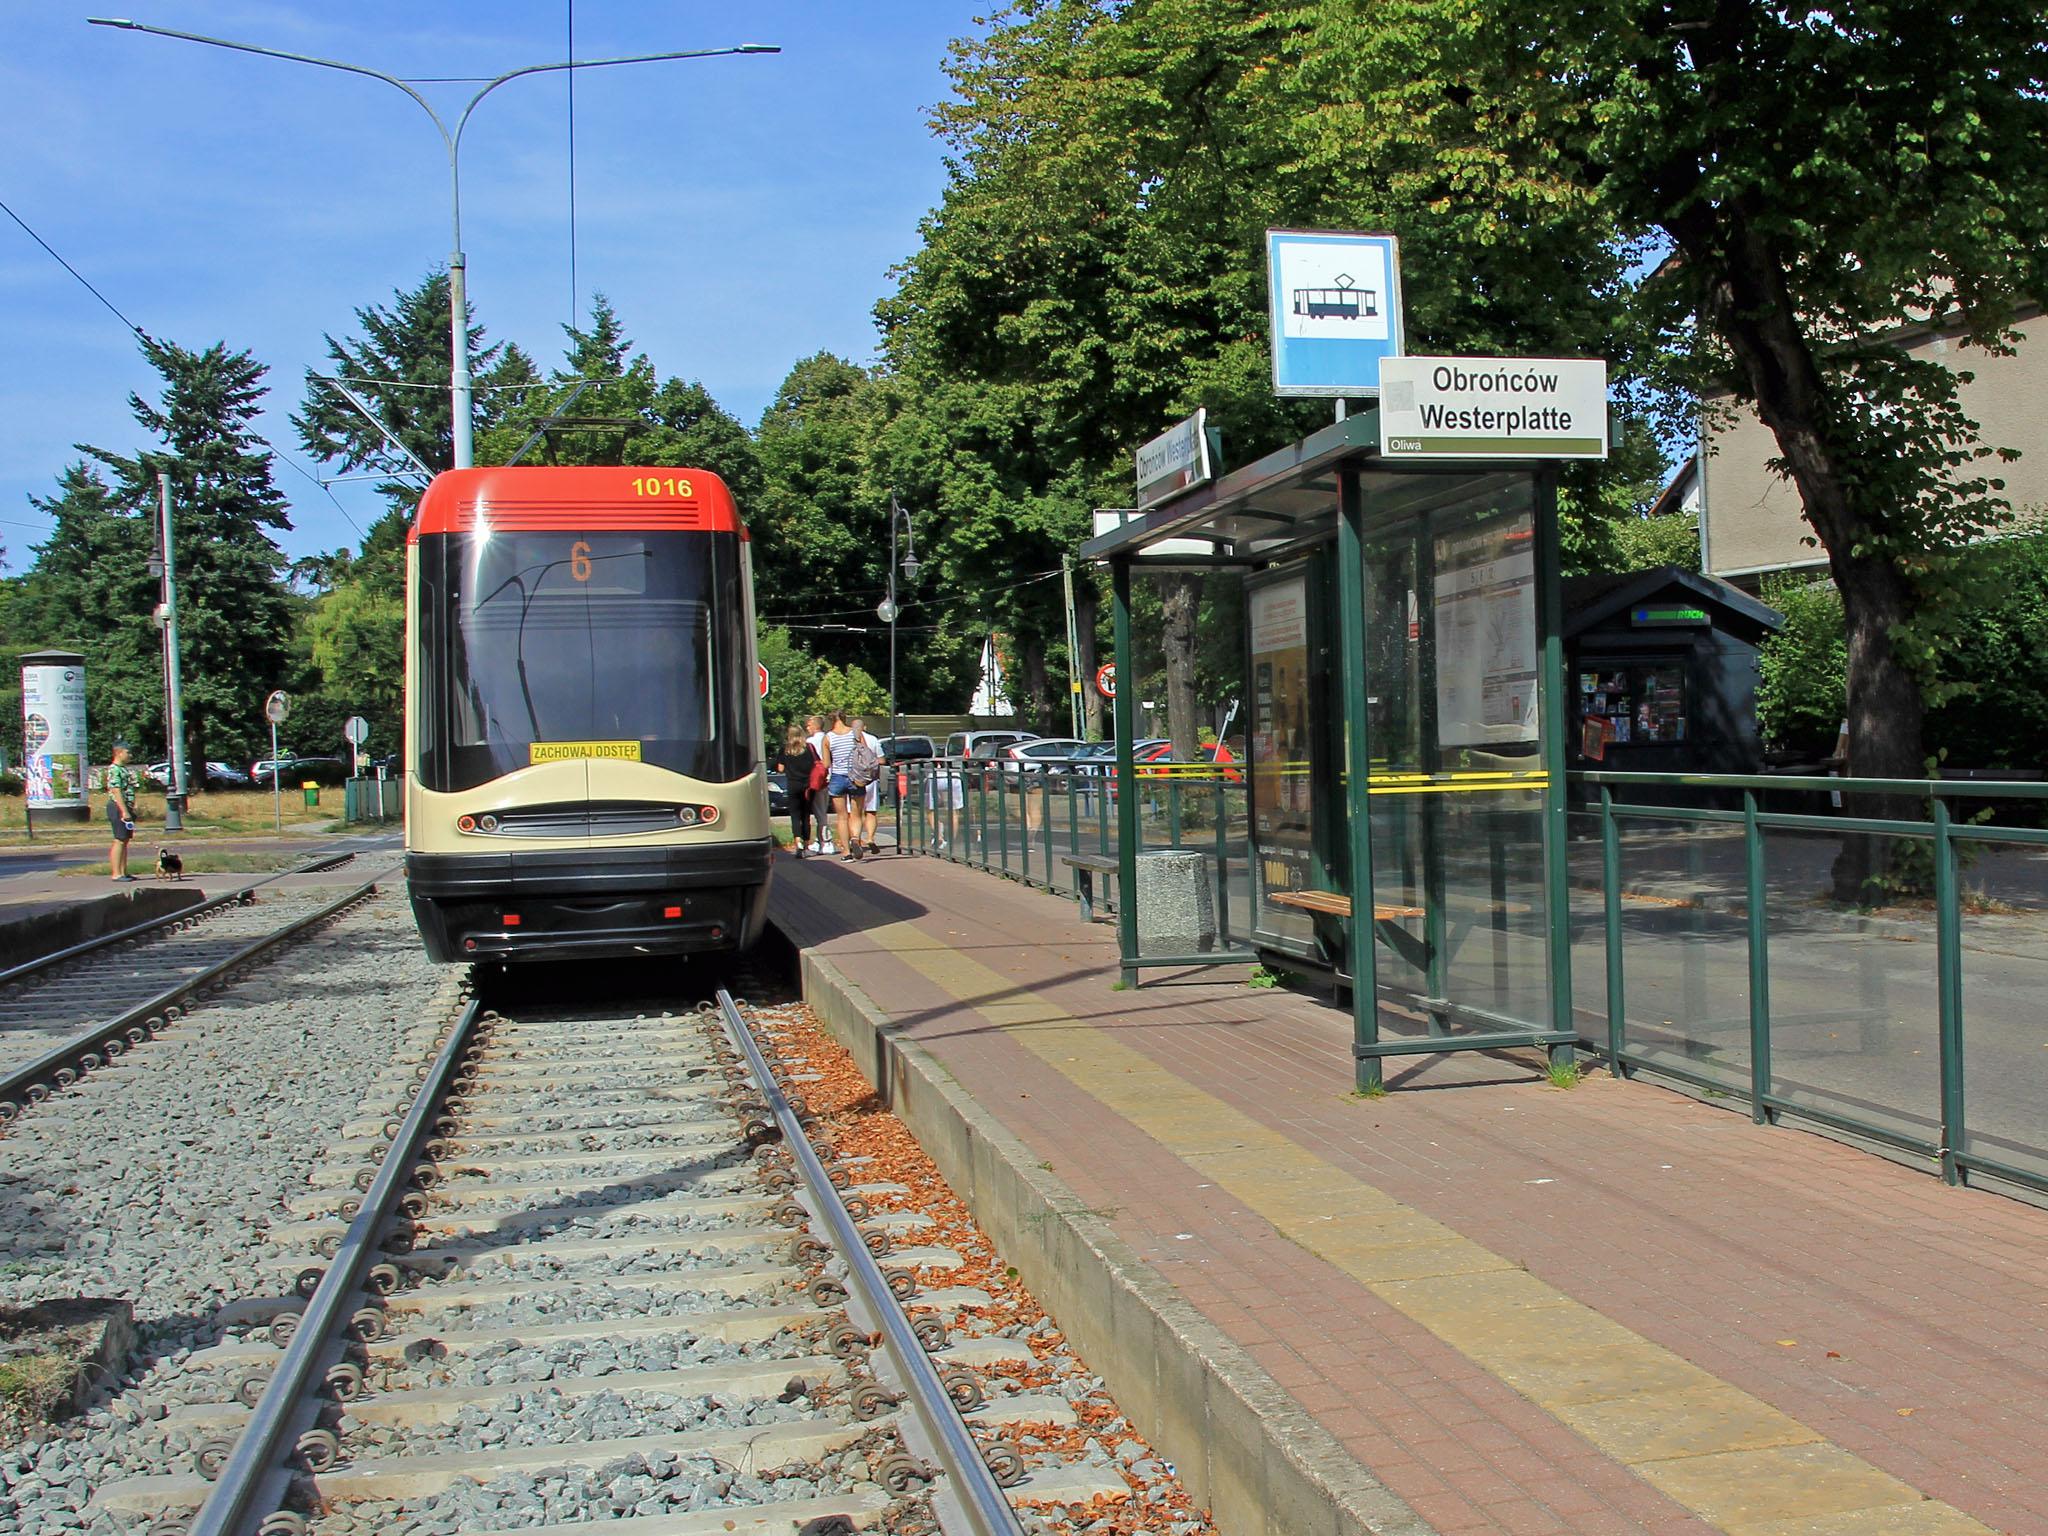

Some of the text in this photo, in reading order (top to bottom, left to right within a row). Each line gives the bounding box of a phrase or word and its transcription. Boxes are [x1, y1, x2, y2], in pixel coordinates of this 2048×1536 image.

[1433, 366, 1558, 392] Obrońców
[1419, 404, 1572, 435] Westerplatte
[1390, 439, 1422, 451] Oliwa
[632, 477, 693, 497] 1016
[571, 541, 592, 582] 6
[534, 745, 637, 759] ZACHOWAJ ODSTĘP
